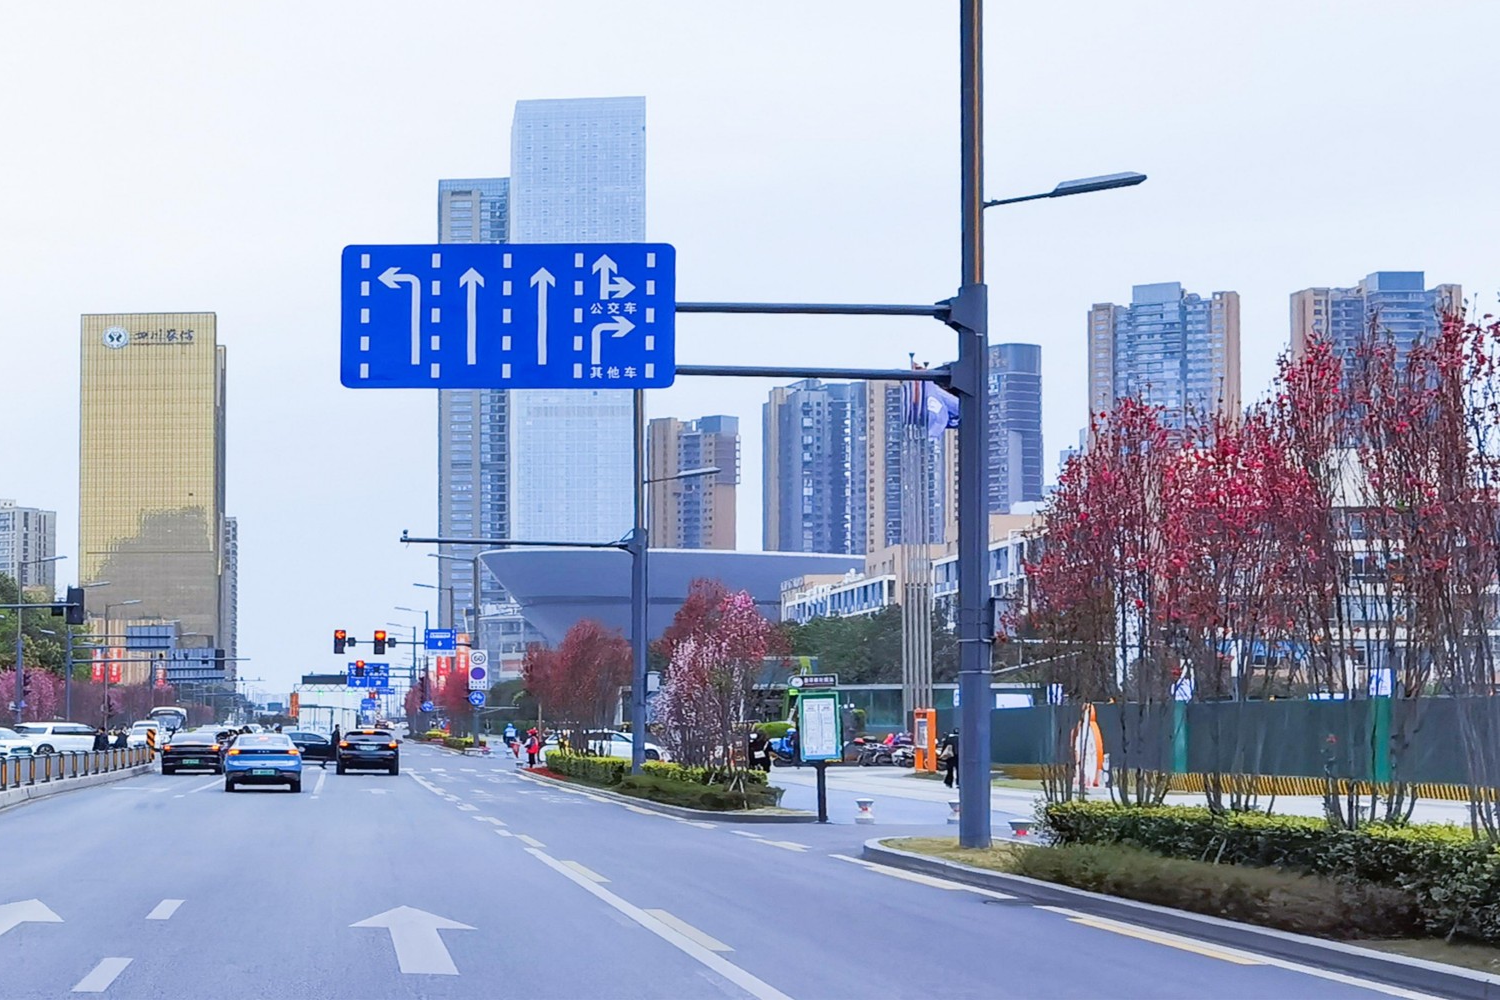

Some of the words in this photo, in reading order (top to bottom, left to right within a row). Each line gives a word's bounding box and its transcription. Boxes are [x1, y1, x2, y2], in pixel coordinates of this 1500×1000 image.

[589, 302, 637, 315] 公交车
[589, 366, 638, 379] 其他车
